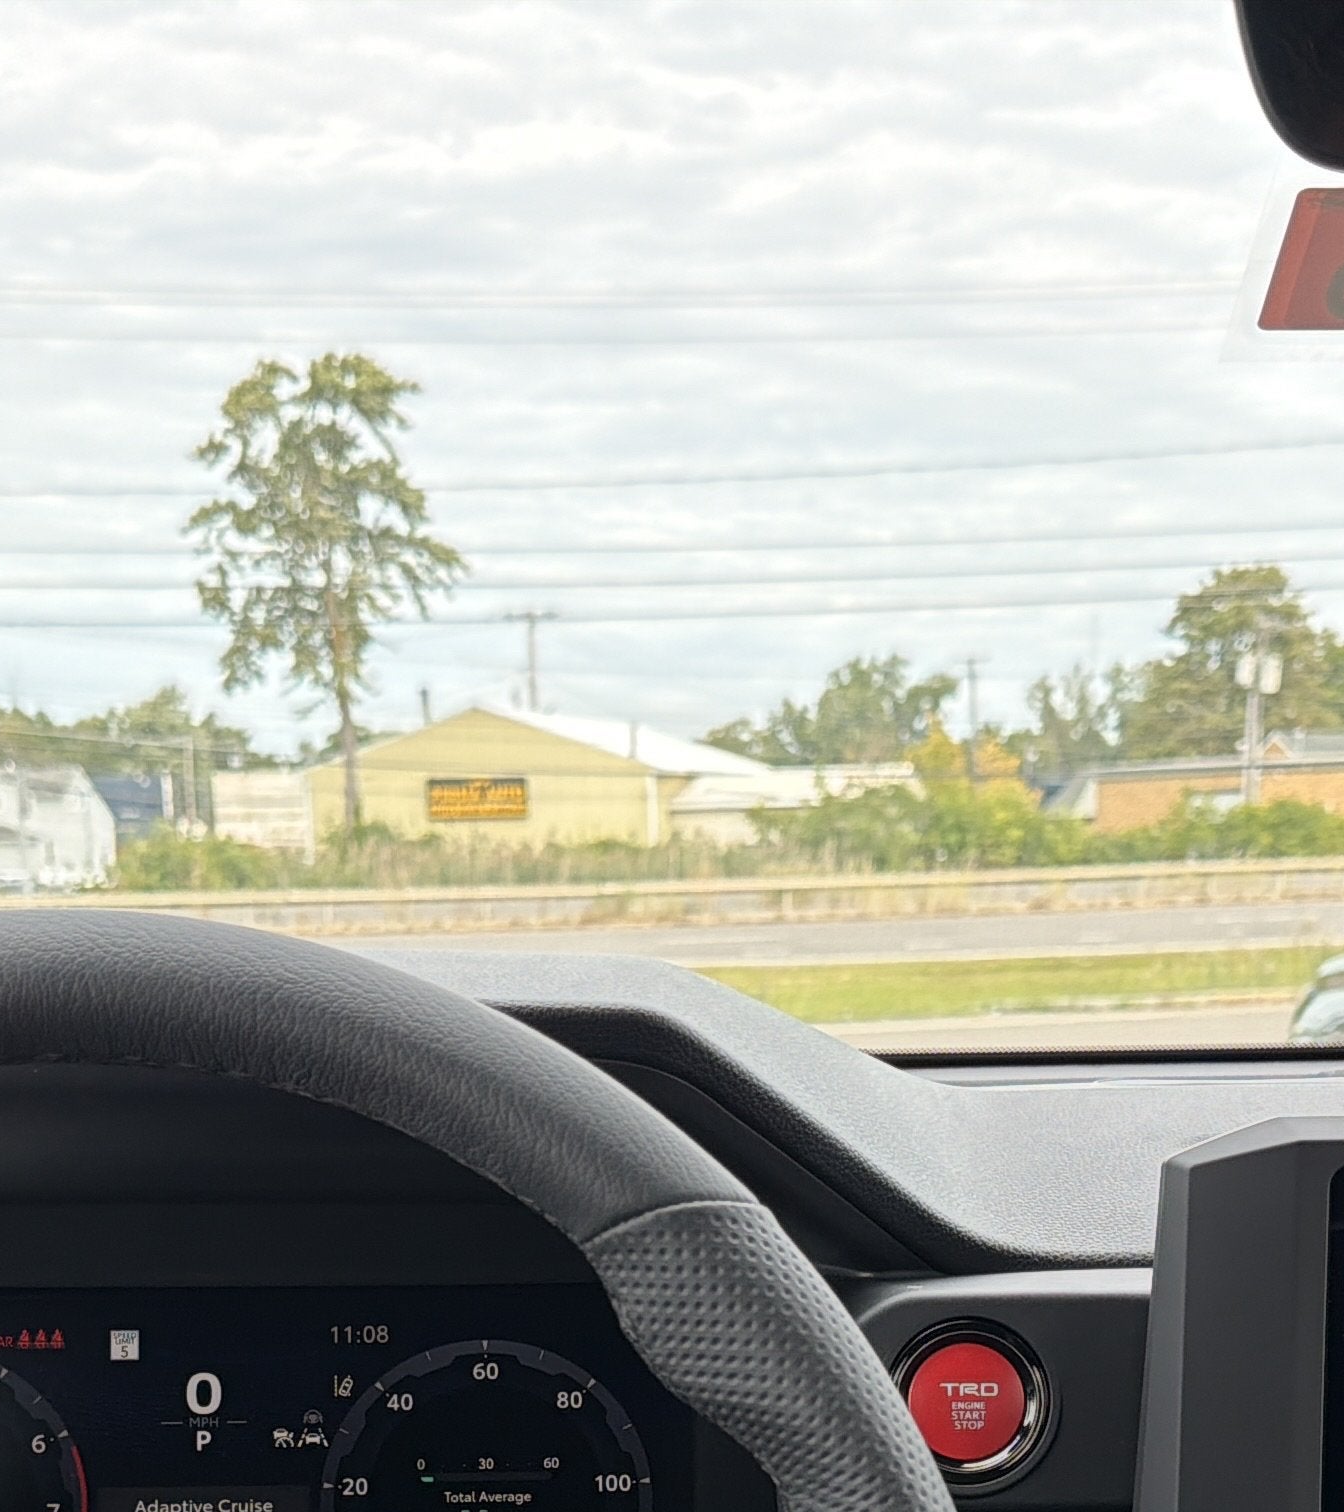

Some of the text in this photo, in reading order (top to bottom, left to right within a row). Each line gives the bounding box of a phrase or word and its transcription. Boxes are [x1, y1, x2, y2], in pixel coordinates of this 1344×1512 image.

[330, 1325, 389, 1344] 11:08
[121, 1346, 129, 1358] 5
[472, 1363, 499, 1381] 60
[186, 1373, 222, 1414] 0
[939, 1382, 999, 1397] TRD
[387, 1394, 413, 1412] 40
[557, 1391, 583, 1409] 80
[951, 1401, 986, 1410] ENGINE
[189, 1417, 219, 1428] MPH
[951, 1411, 986, 1420] START
[954, 1420, 985, 1430] STOP
[32, 1434, 46, 1454] 6
[196, 1431, 212, 1451] P
[416, 1457, 559, 1470] 0 30 60
[342, 1478, 368, 1496] 20
[594, 1475, 631, 1493] 100
[444, 1491, 532, 1505] Total Average
